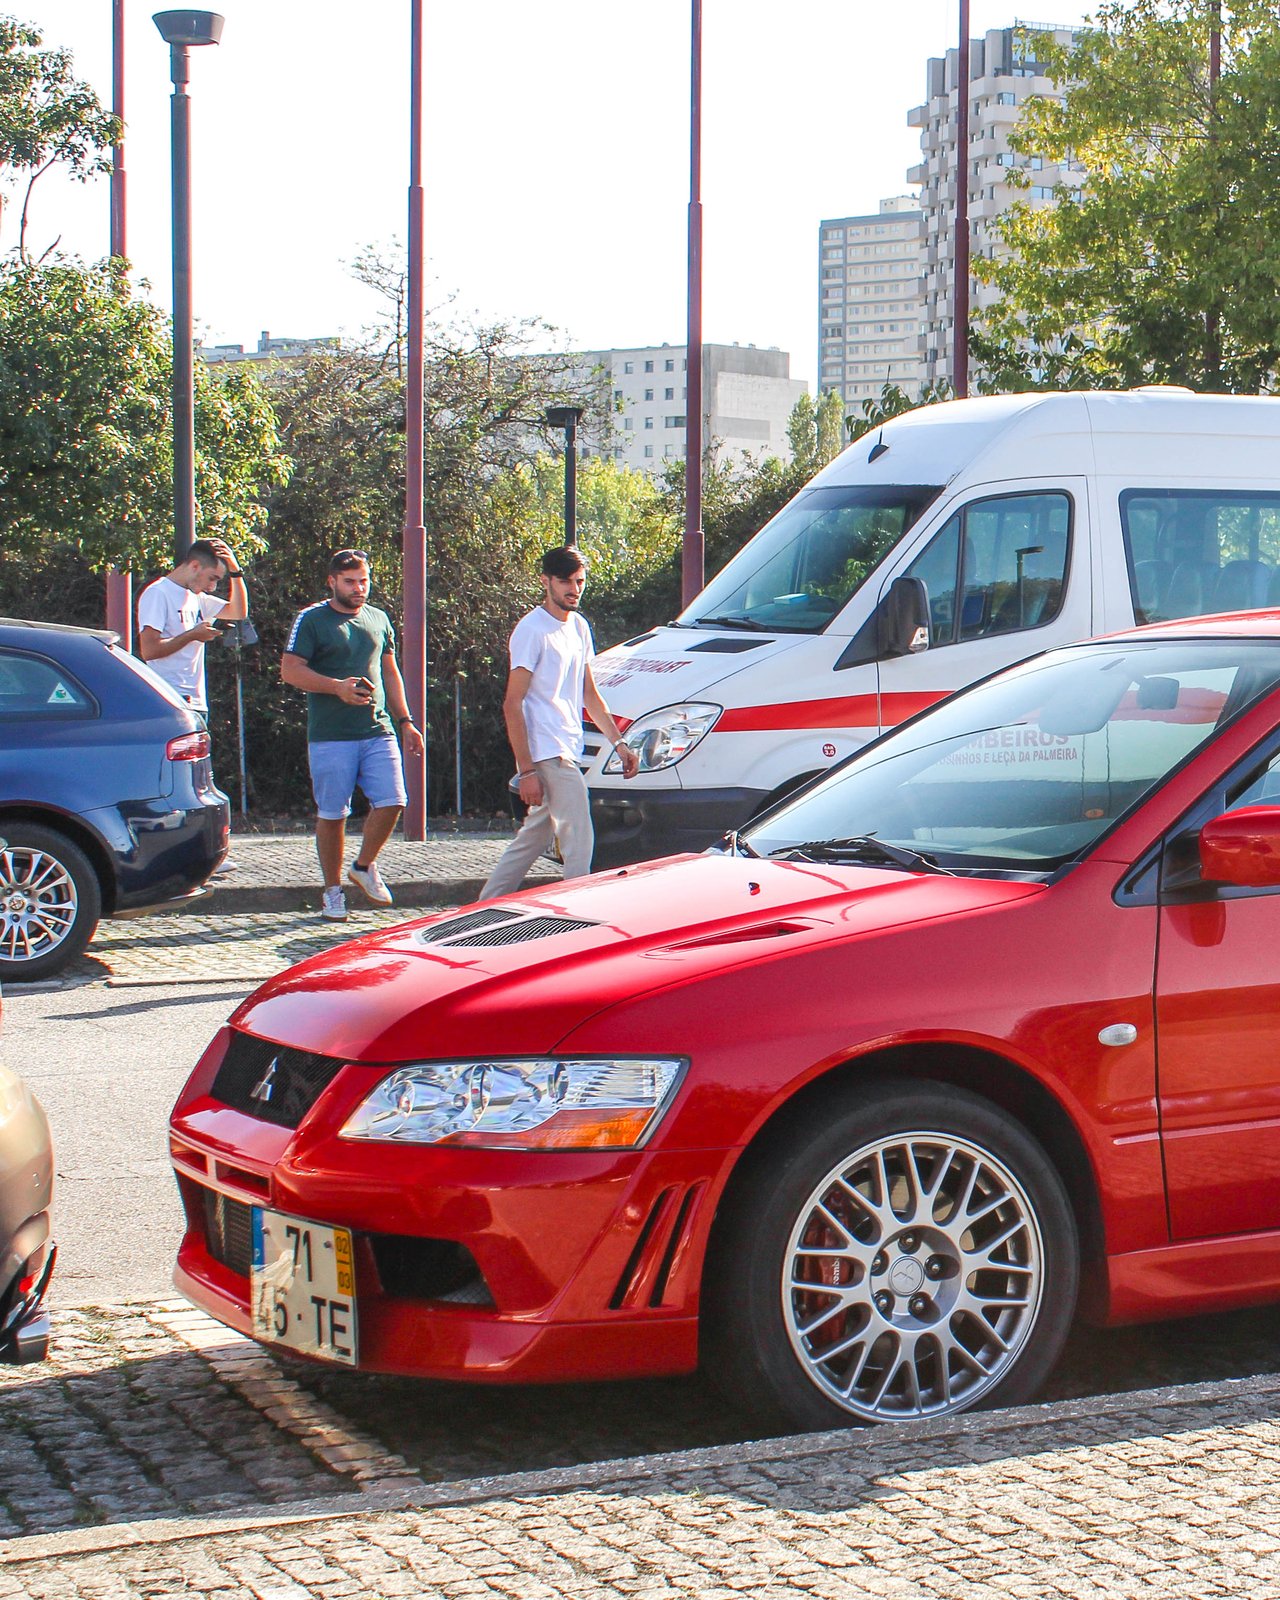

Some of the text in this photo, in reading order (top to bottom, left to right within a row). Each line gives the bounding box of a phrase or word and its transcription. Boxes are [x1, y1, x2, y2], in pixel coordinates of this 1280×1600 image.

[964, 730, 1069, 749] MBEIROS
[984, 752, 991, 764] E
[1019, 751, 1031, 763] DA
[1033, 747, 1078, 762] PALMEIRA
[286, 1225, 313, 1282] 71
[335, 1236, 349, 1254] 02
[339, 1271, 351, 1289] 03
